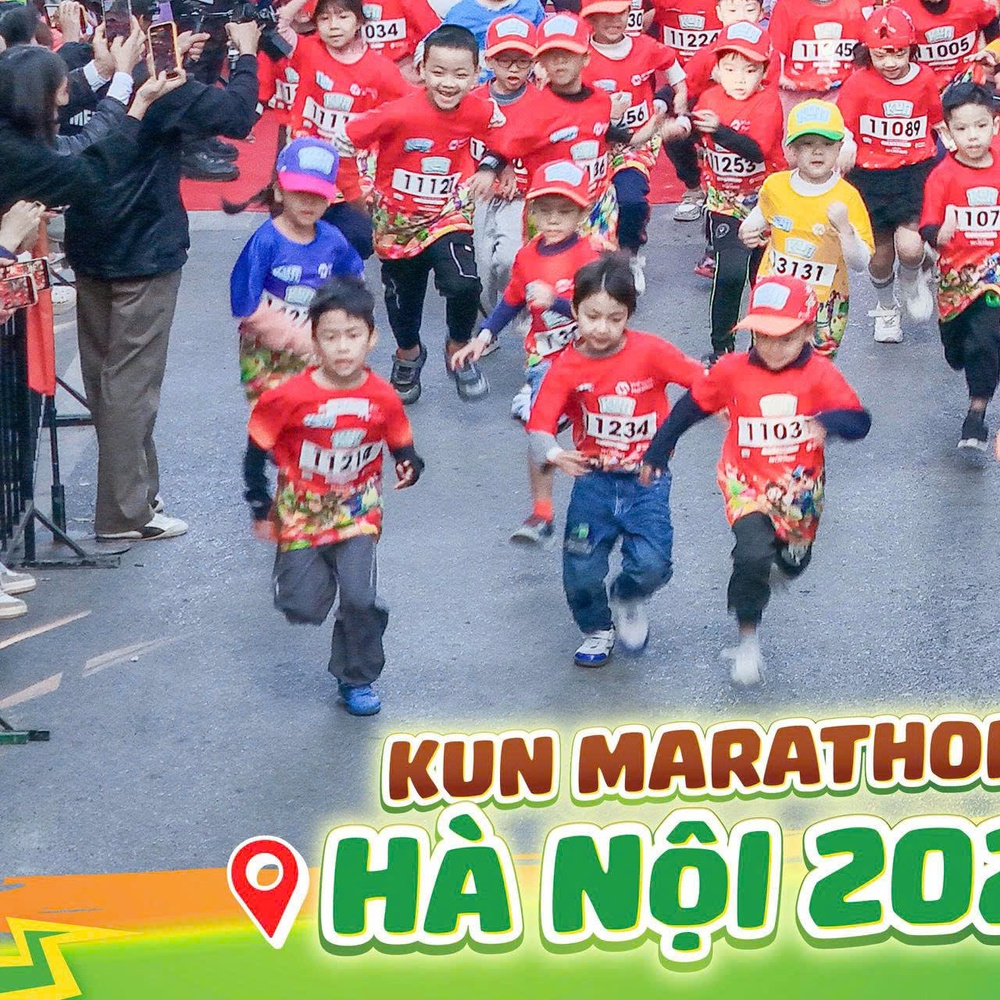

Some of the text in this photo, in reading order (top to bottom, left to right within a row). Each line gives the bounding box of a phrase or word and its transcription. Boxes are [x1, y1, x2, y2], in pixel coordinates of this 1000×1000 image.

[364, 22, 399, 40] 034
[801, 41, 854, 58] 1145
[868, 118, 922, 138] 11089
